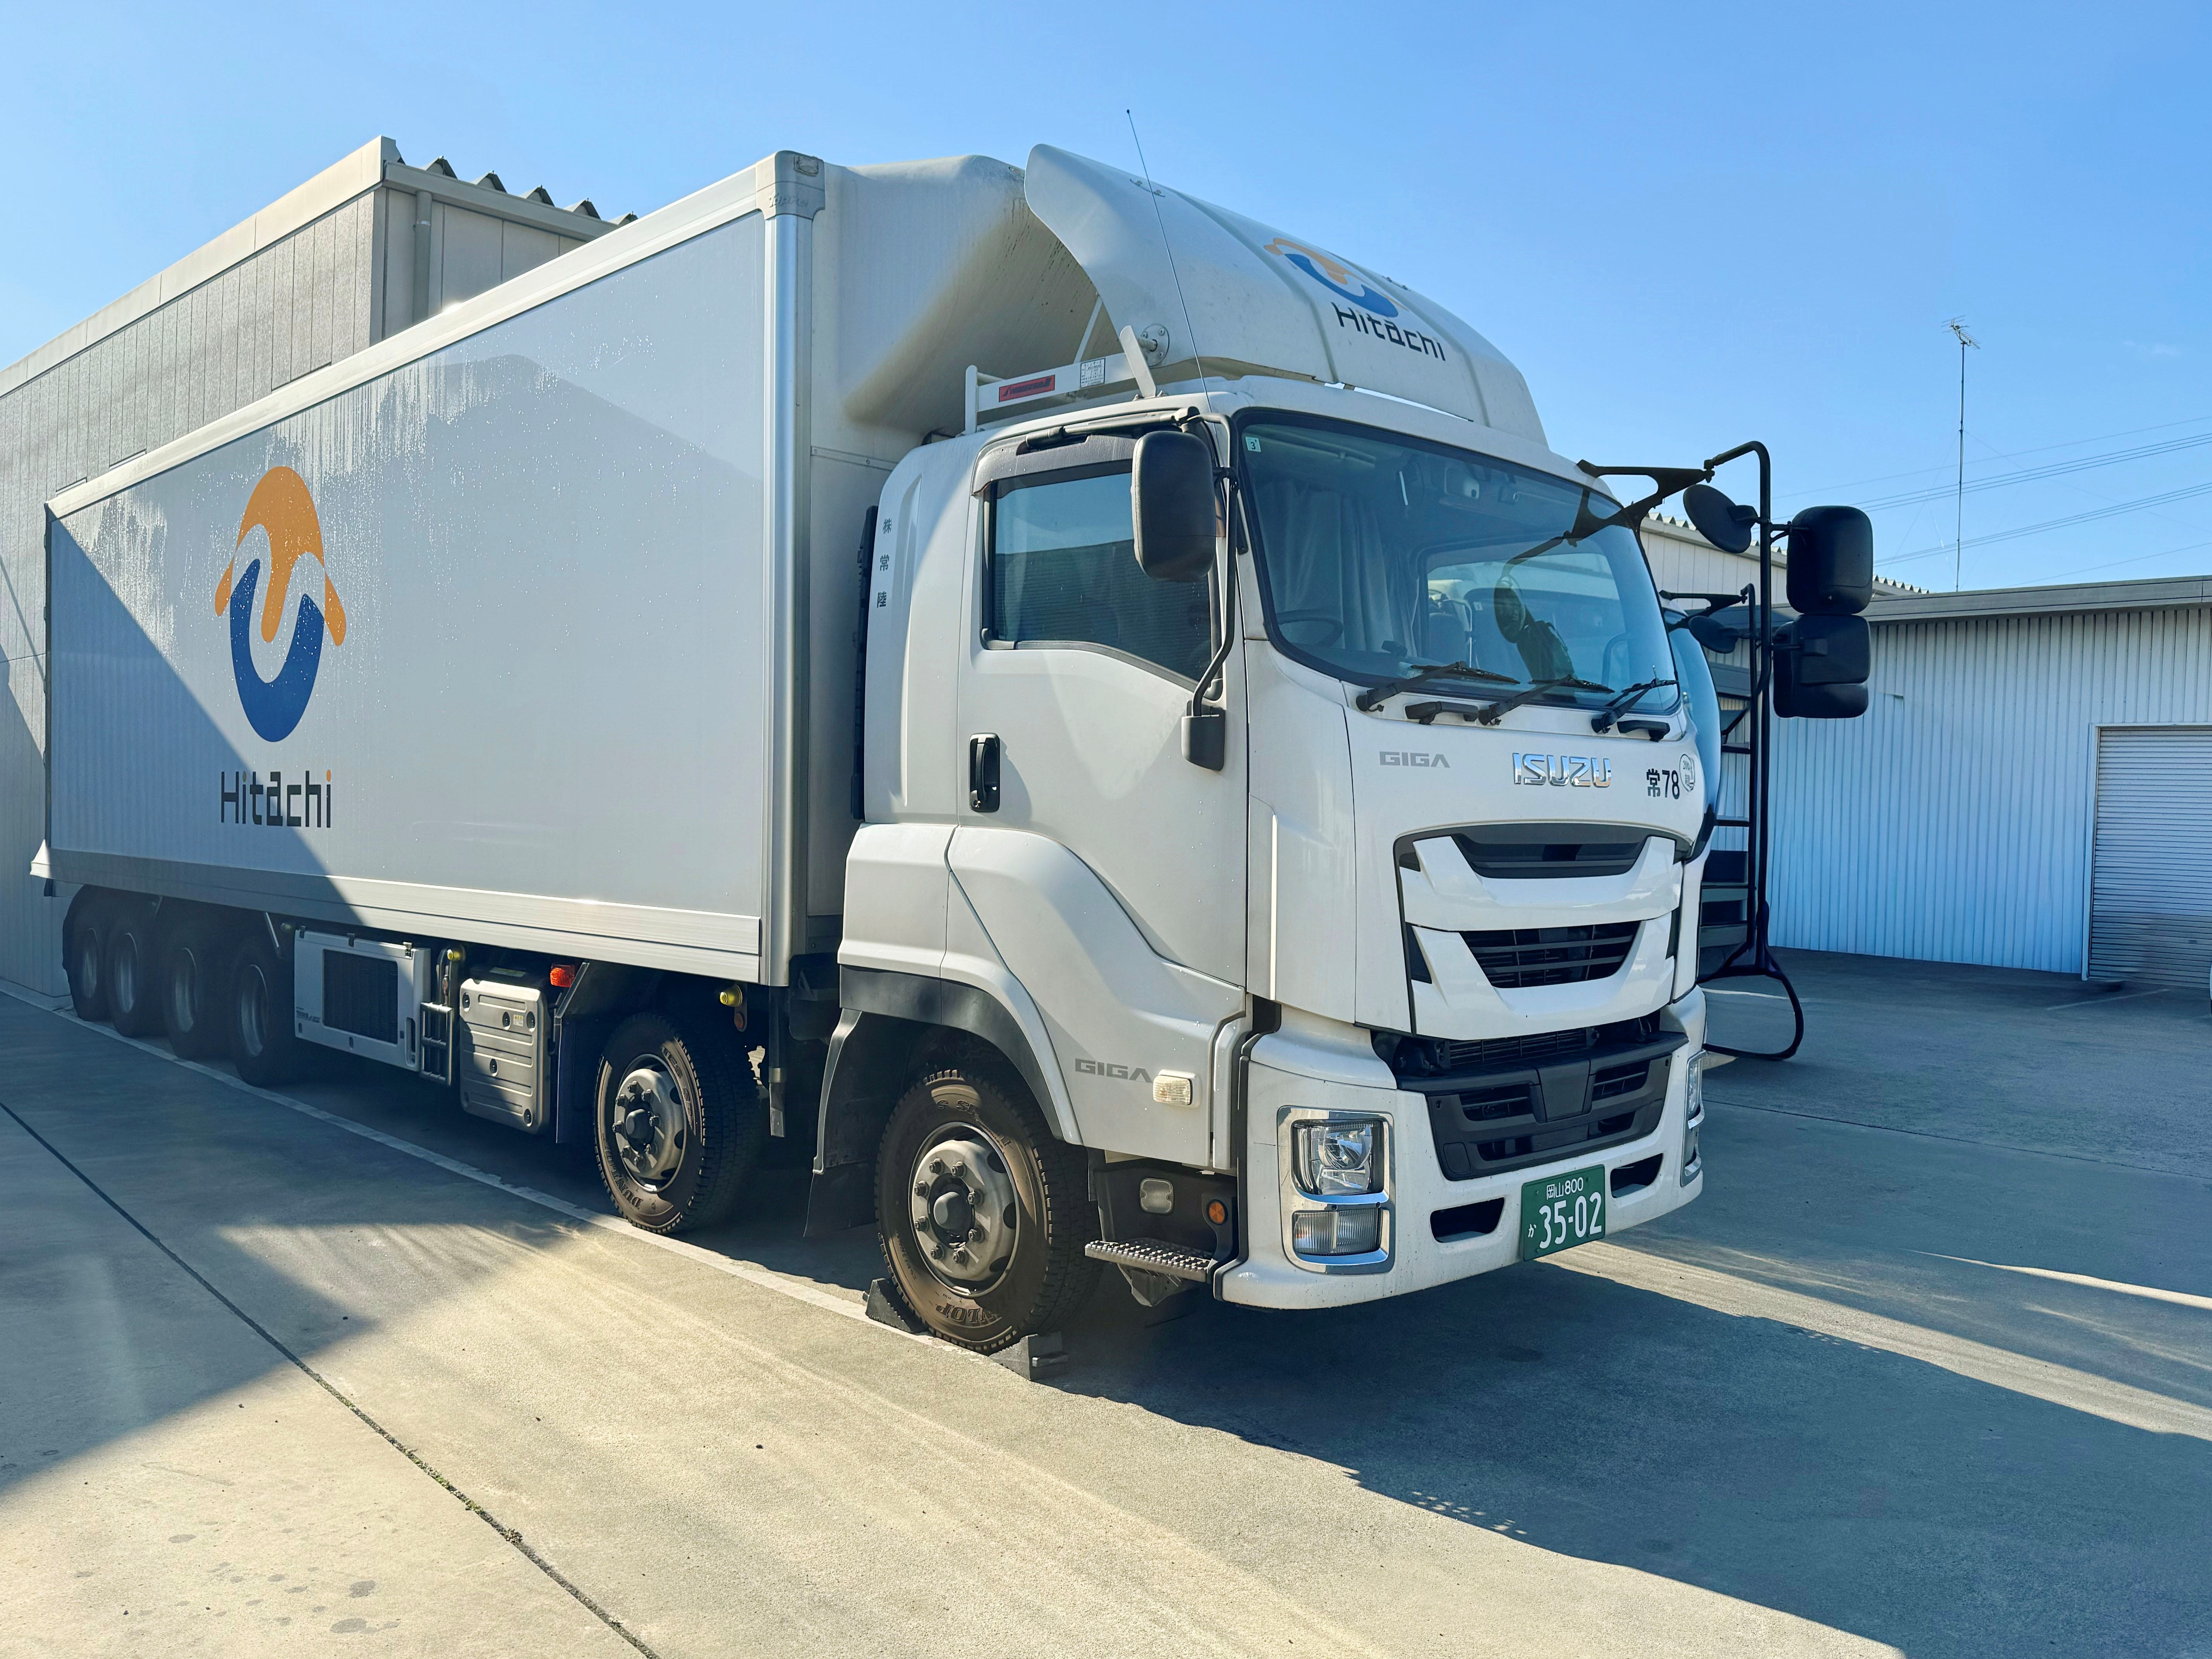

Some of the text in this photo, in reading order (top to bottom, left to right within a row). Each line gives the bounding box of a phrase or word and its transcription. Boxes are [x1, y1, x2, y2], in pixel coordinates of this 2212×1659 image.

[1331, 302, 1446, 361] Hitachi
[1379, 751, 1450, 768] GIGA
[1512, 752, 1612, 788] ISUZU
[221, 769, 331, 828] Hitachi
[1075, 1058, 1153, 1083] GIGA
[1528, 1192, 1602, 1249] か 35-02
